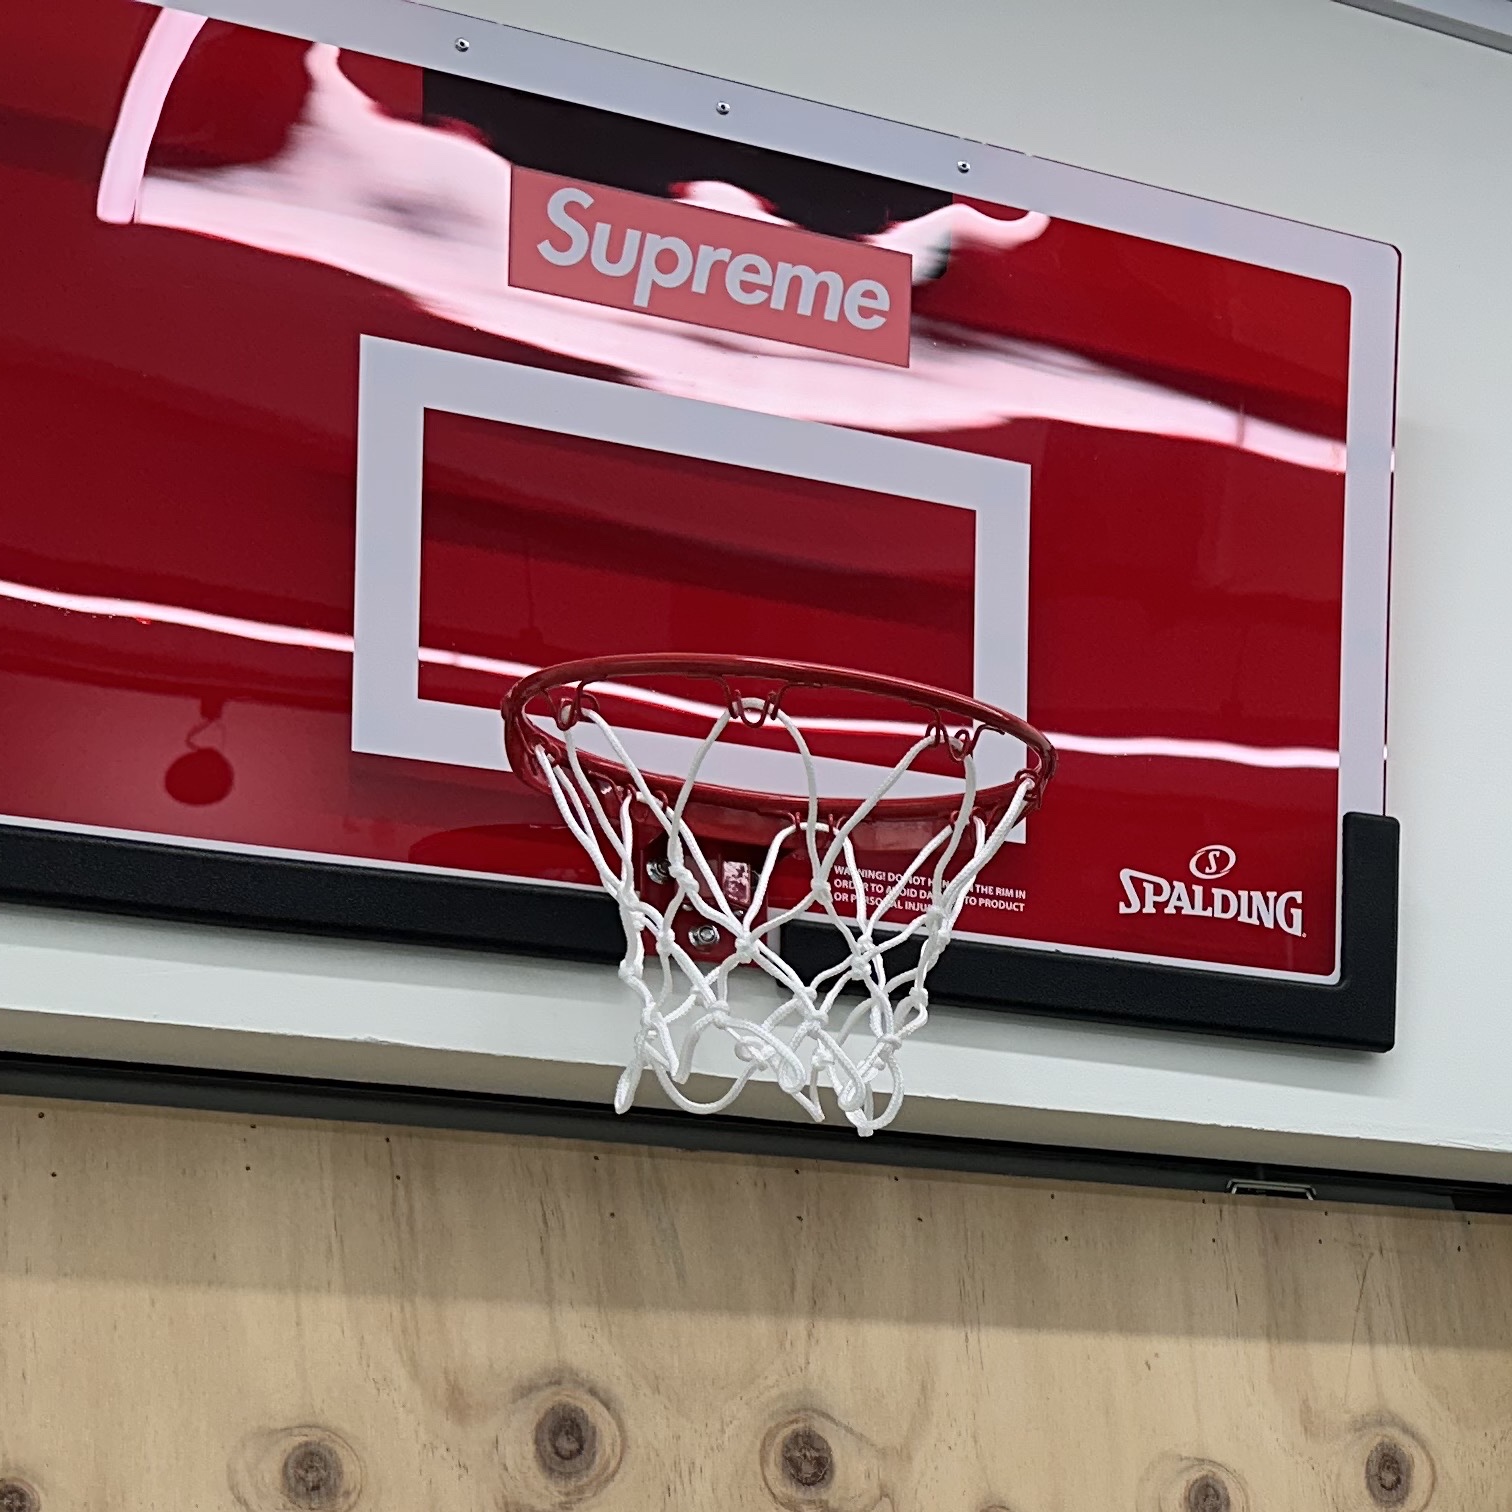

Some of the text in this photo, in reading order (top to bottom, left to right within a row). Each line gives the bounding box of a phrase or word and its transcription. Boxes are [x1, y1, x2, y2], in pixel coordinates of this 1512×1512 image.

[537, 187, 890, 331] Supreme
[834, 865, 886, 881] WANING!
[887, 872, 903, 882] DO
[975, 883, 994, 896] THE
[996, 886, 1014, 898] RIM
[1015, 889, 1026, 900] IN
[834, 878, 868, 892] ORDR
[870, 883, 884, 894] TO
[886, 886, 917, 898] AOID
[964, 896, 977, 905] TO
[979, 897, 1025, 912] PRODUCT
[834, 892, 849, 902] OR
[1119, 868, 1303, 937] SPALDING
